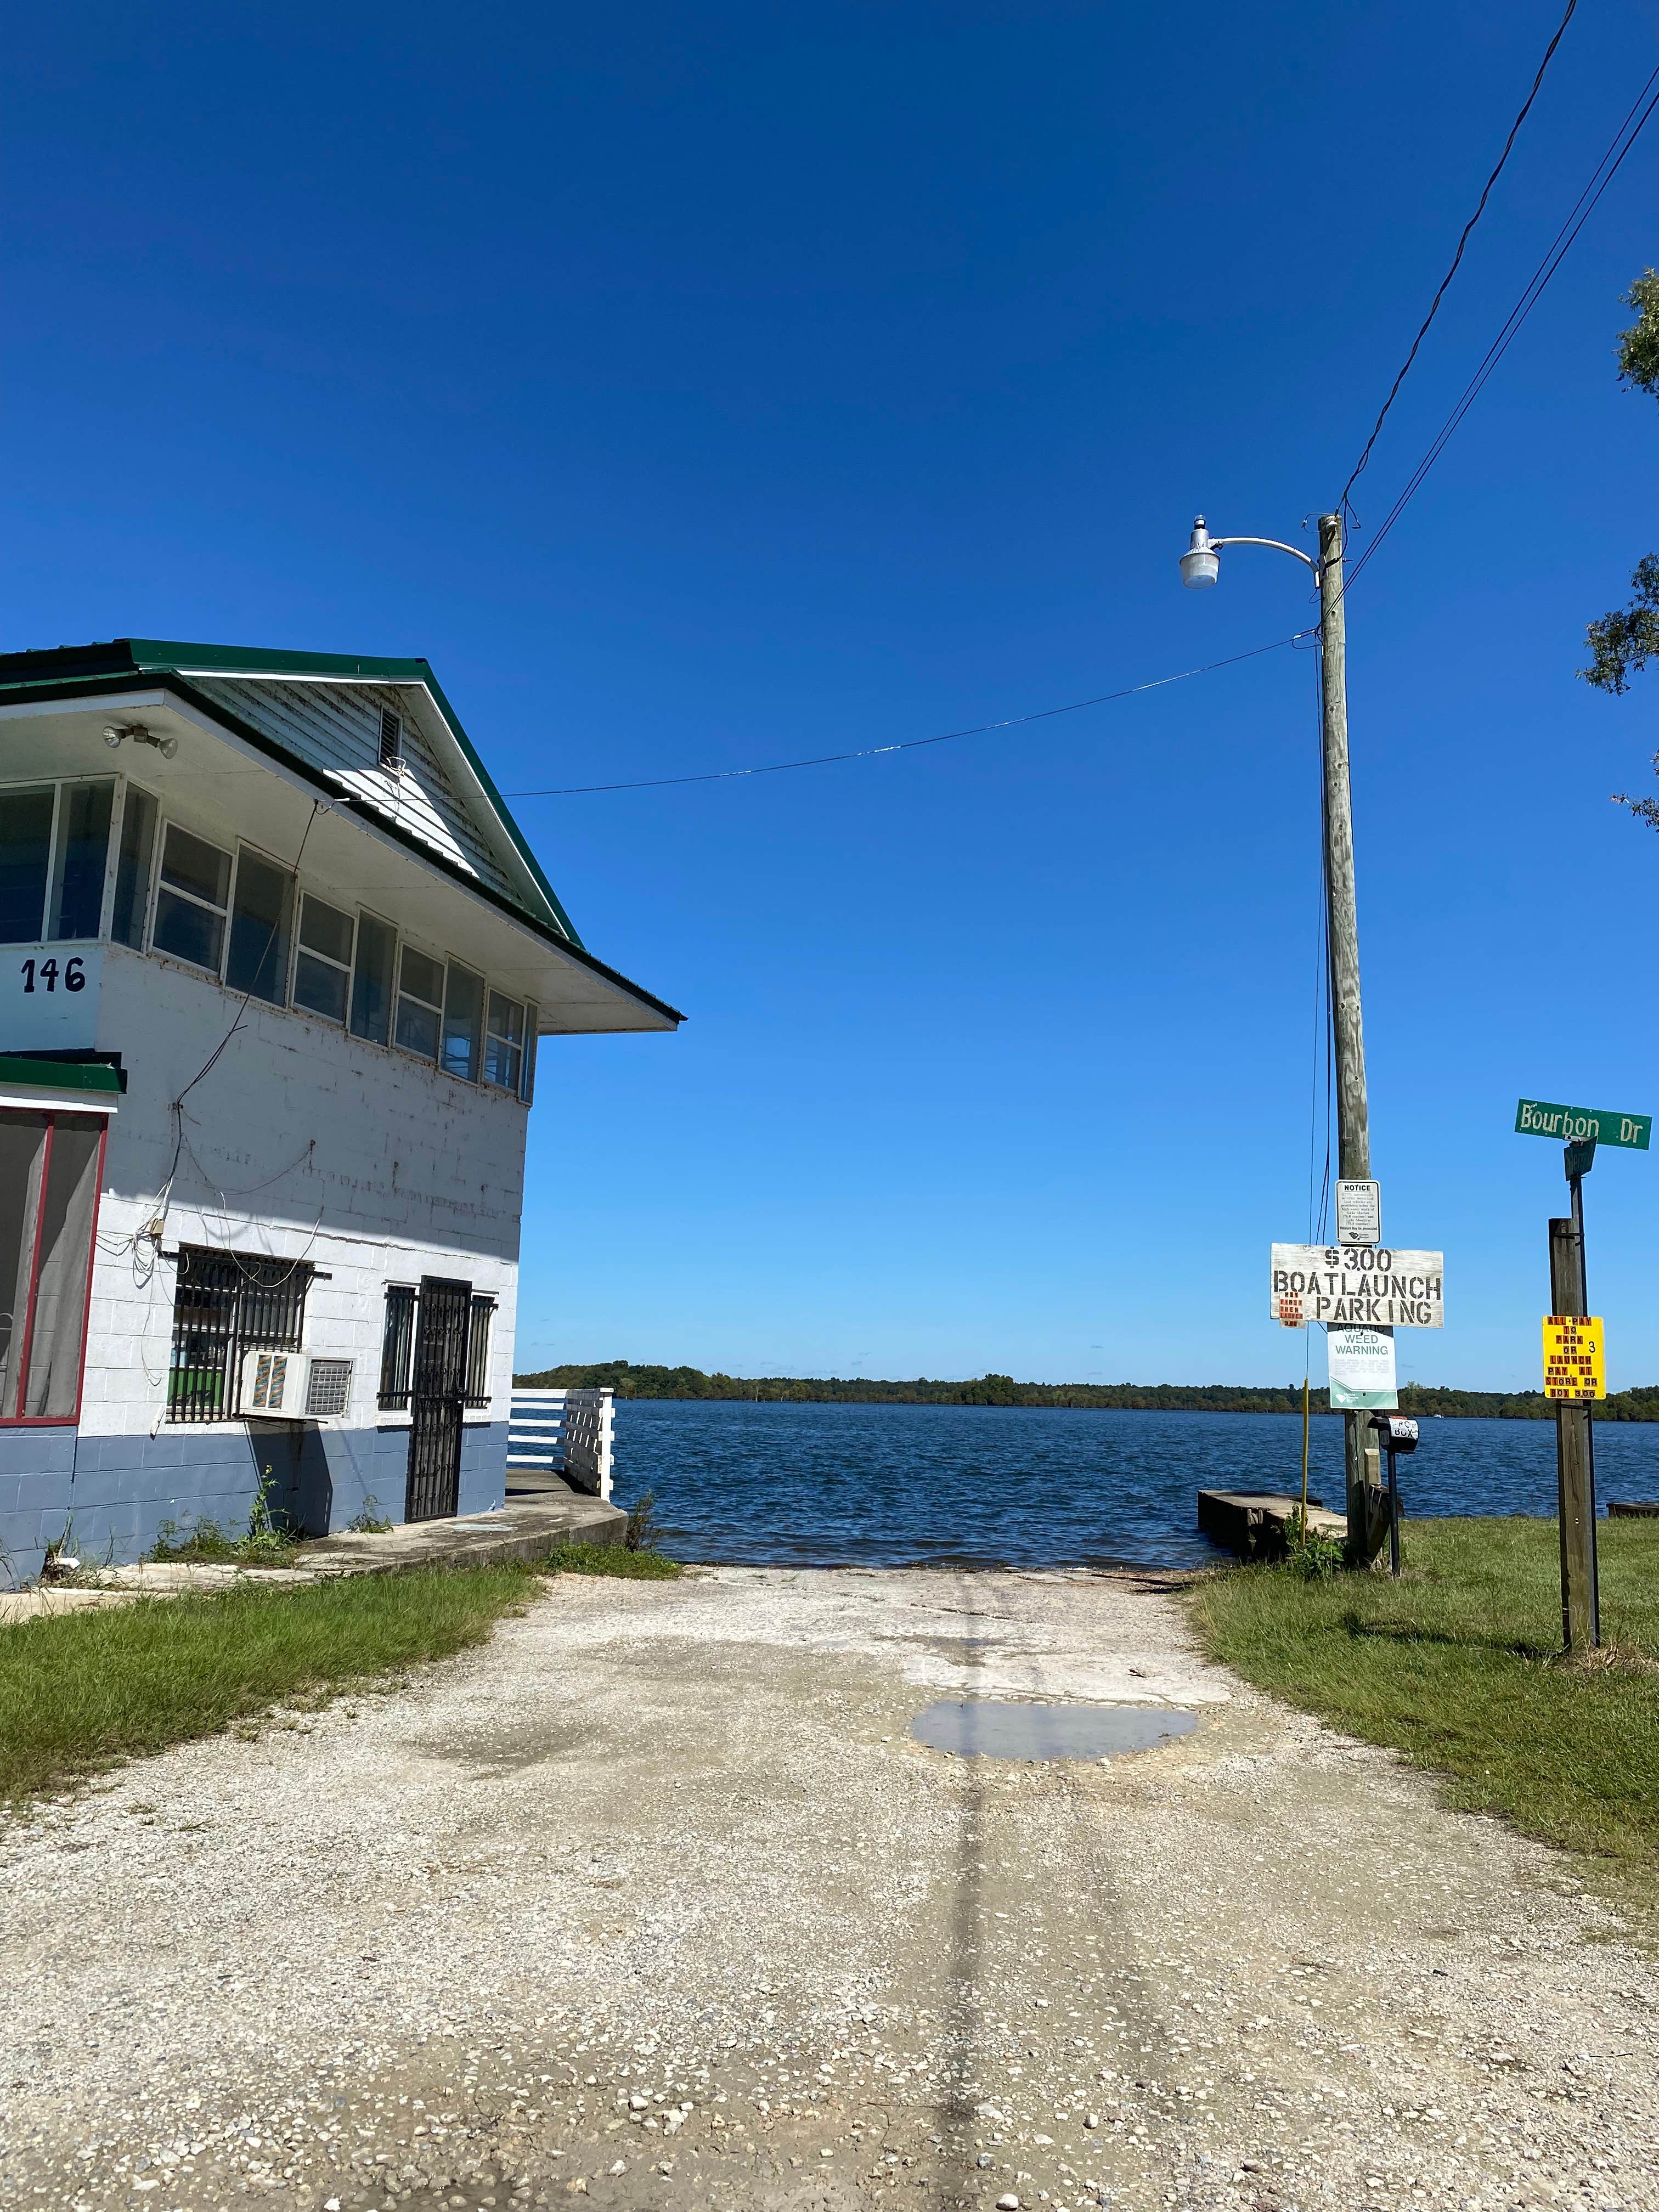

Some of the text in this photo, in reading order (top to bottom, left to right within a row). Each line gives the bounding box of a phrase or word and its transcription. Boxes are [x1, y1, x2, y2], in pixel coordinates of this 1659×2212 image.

[21, 957, 85, 992] 146
[1520, 1103, 1643, 1143] Bourbon Dr
[1325, 1246, 1392, 1272] $3.00
[1317, 1297, 1431, 1324] PARKING
[1548, 1317, 1592, 1325] ALL PAY
[1564, 1326, 1576, 1334] TO
[1345, 1335, 1378, 1344] WEED
[1556, 1335, 1583, 1344] PARK
[1335, 1346, 1388, 1355] WARNING
[1564, 1346, 1577, 1354] OR
[1588, 1341, 1595, 1353] 3
[1550, 1356, 1591, 1364] LAUNCH
[1548, 1367, 1592, 1375] PAY AT
[1545, 1376, 1597, 1386] STORE OR
[1550, 1389, 1595, 1398] BOX 3.00
